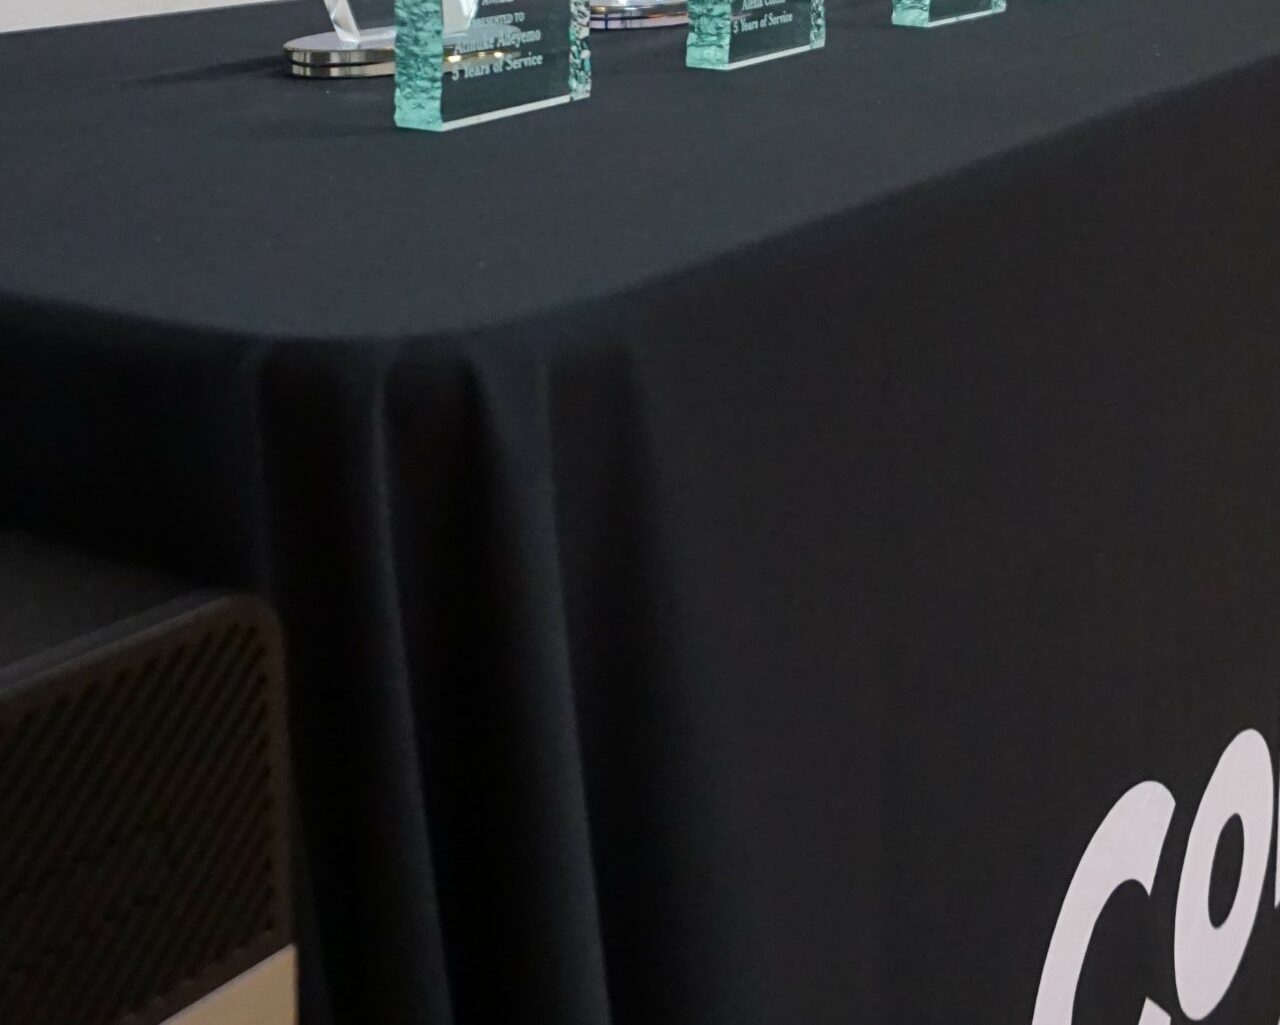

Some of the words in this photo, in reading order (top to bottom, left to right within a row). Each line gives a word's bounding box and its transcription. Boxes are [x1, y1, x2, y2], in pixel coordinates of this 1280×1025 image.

[514, 12, 526, 23] TO
[733, 20, 739, 34] 5
[740, 17, 759, 33] Years
[760, 13, 768, 28] of
[768, 10, 793, 26] Service
[451, 64, 460, 81] 5
[464, 61, 490, 79] Years
[493, 60, 505, 74] of
[505, 51, 544, 72] Service
